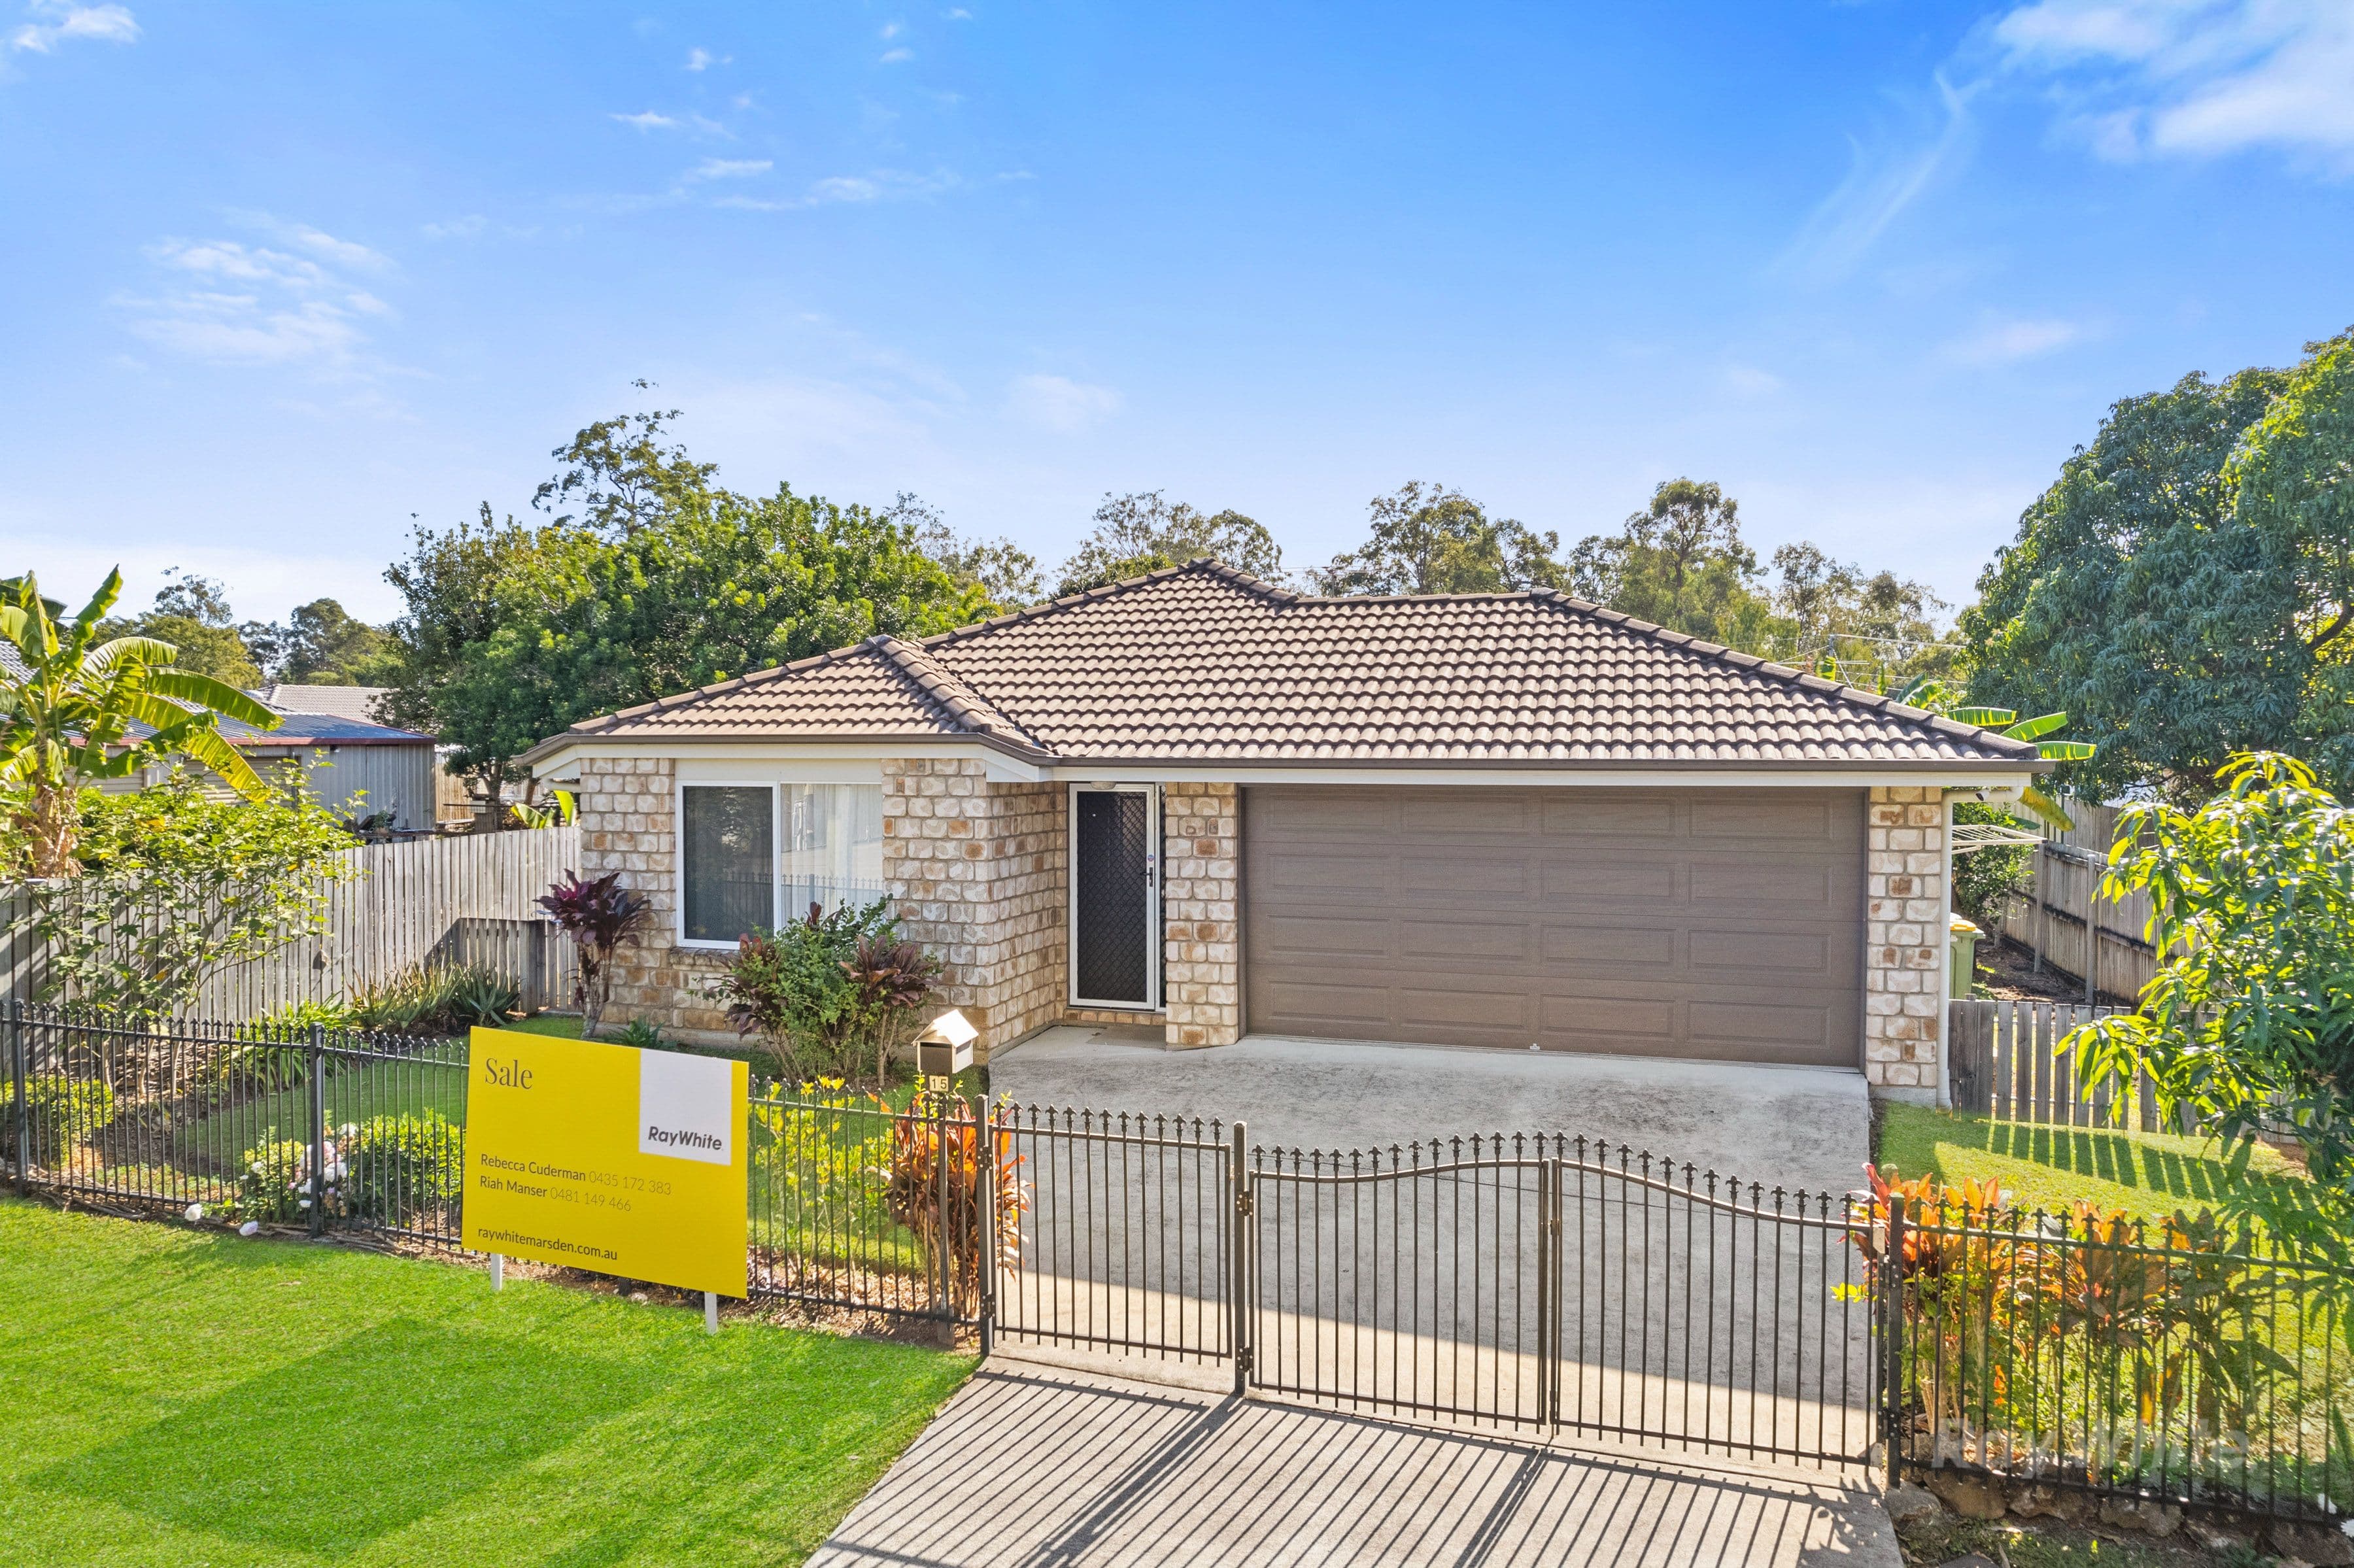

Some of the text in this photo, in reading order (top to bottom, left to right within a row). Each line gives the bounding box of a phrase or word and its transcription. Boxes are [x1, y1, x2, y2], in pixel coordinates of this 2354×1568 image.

[485, 1058, 533, 1089] Sale
[932, 1078, 947, 1089] 15
[648, 1126, 722, 1150] RayWhite
[481, 1154, 671, 1195] Rebecca Cuderman 0435 172 383
[480, 1176, 631, 1212] Riah Manser 0481 149 466
[478, 1228, 617, 1260] raywhitemarsden.com.au
